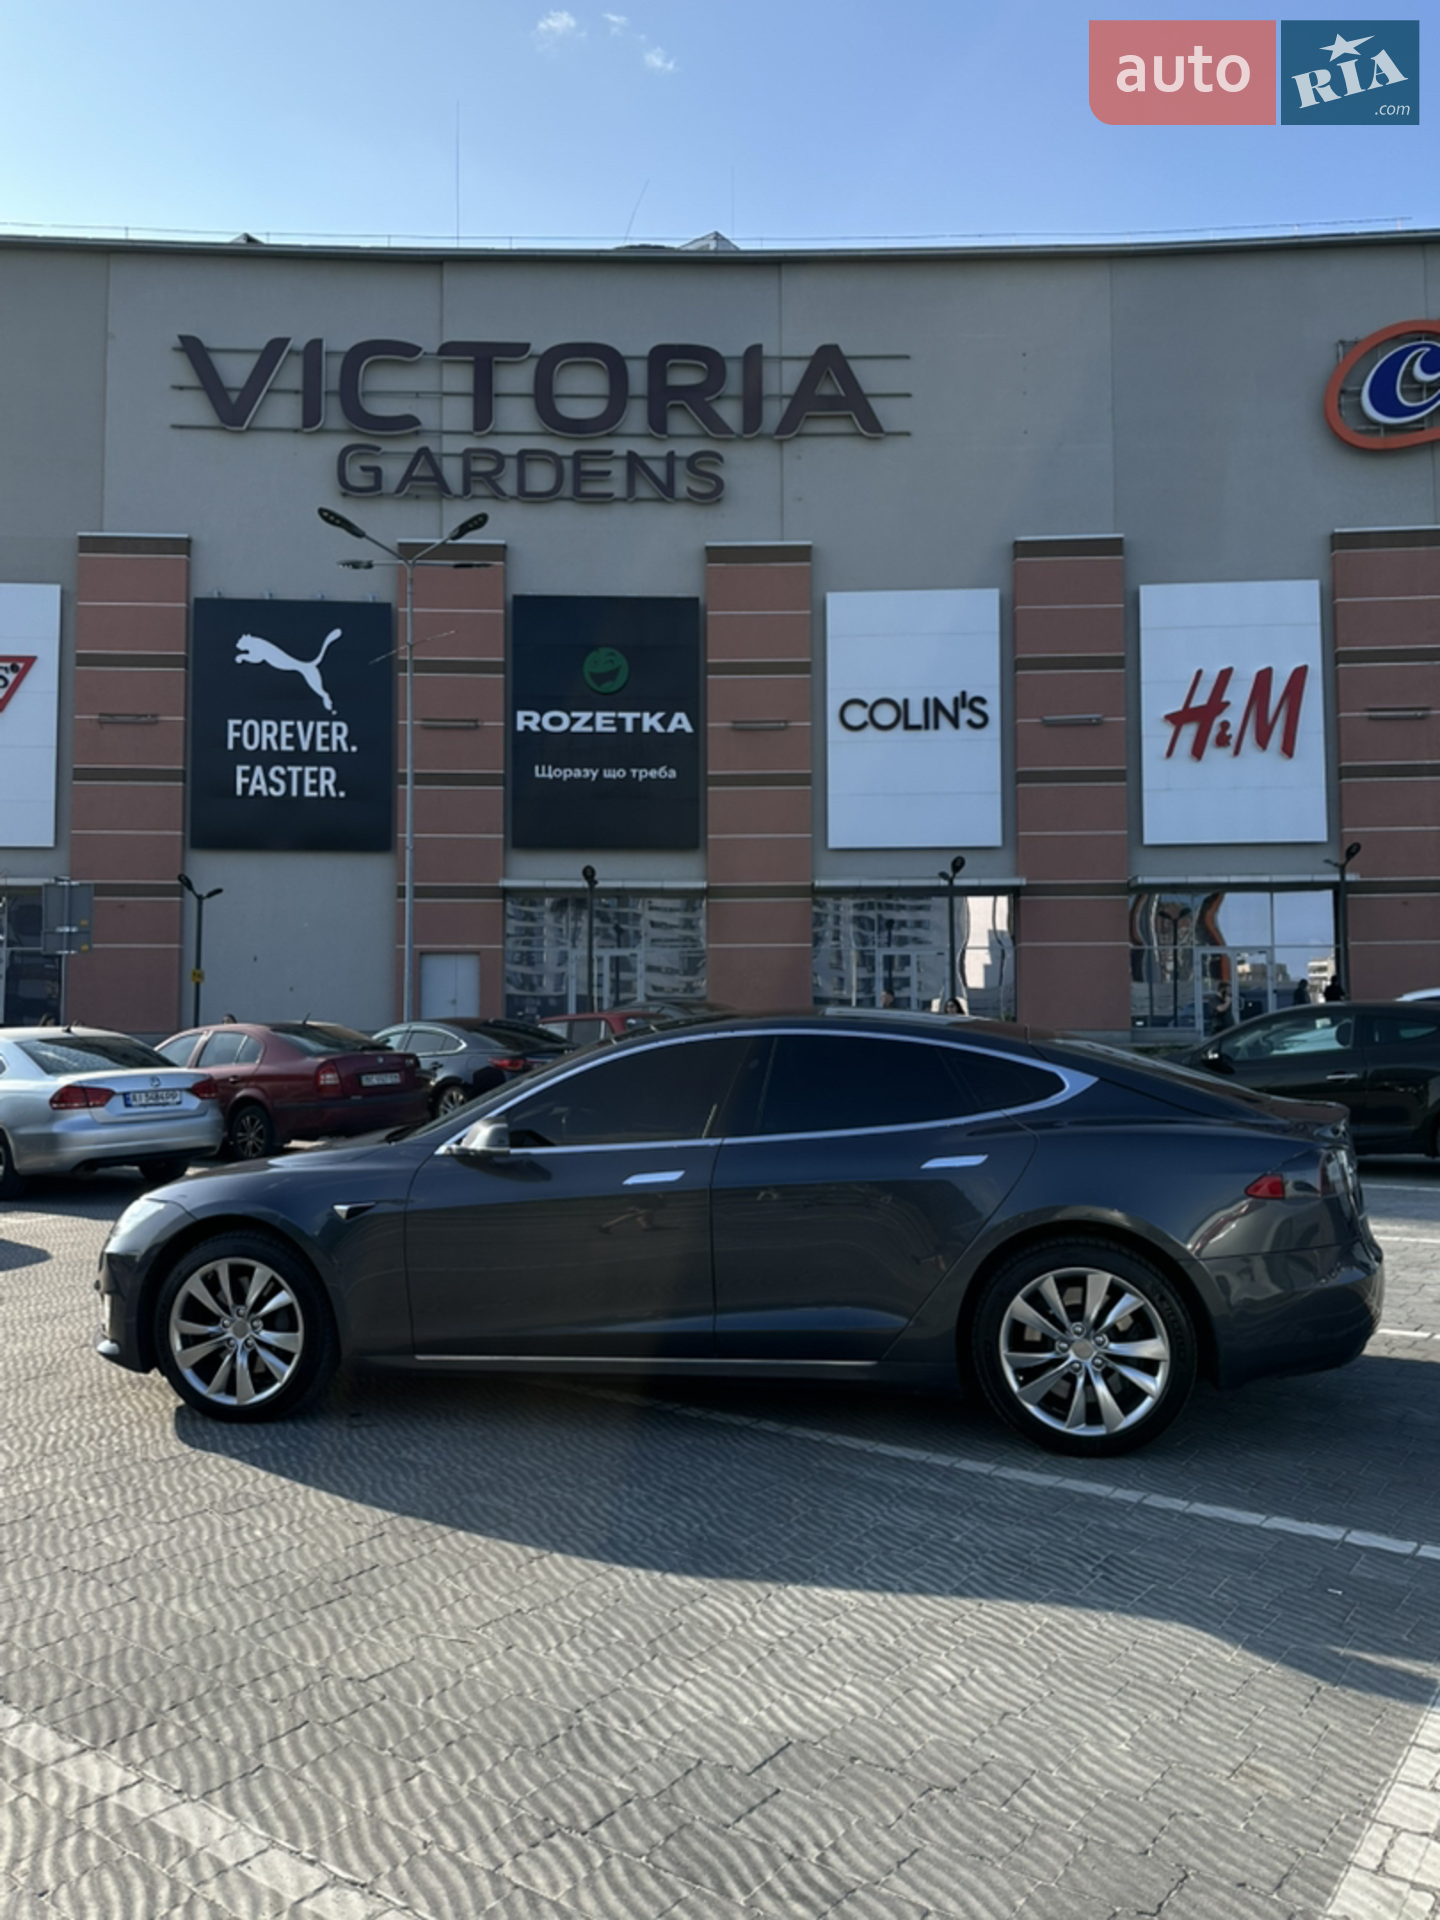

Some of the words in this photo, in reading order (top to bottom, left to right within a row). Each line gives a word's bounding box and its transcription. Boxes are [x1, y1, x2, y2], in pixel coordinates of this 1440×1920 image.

[178, 334, 880, 439] VICTORIA
[338, 443, 724, 504] GARDENS
[516, 710, 694, 733] ROZETKA
[838, 690, 989, 732] COLIN'S
[1164, 664, 1308, 761] H&M
[227, 718, 358, 752] FOREVER.
[235, 764, 346, 798] FASTER.
[534, 764, 600, 781] Щоразу
[602, 767, 627, 780] що
[630, 765, 677, 781] треба
